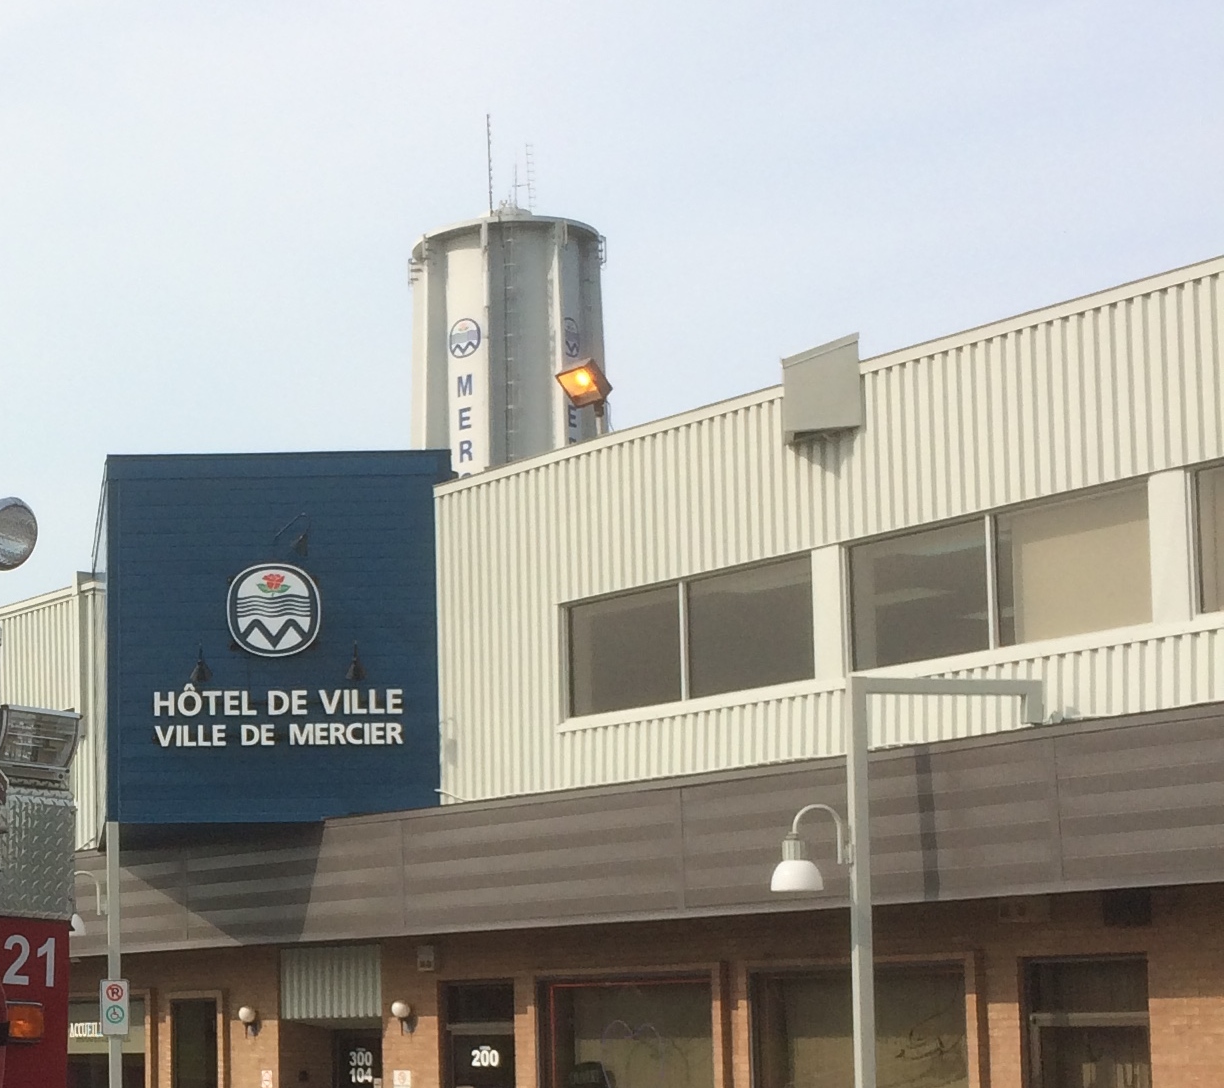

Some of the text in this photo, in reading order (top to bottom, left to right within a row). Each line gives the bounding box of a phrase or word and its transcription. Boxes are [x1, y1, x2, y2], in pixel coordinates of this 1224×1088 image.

[456, 373, 474, 478] MER
[153, 682, 404, 717] HÔTEL DE VILLE
[154, 722, 404, 748] VILLE DE MERCIER
[349, 1051, 374, 1067] 300
[471, 1049, 500, 1067] 200
[349, 1067, 374, 1083] 104
